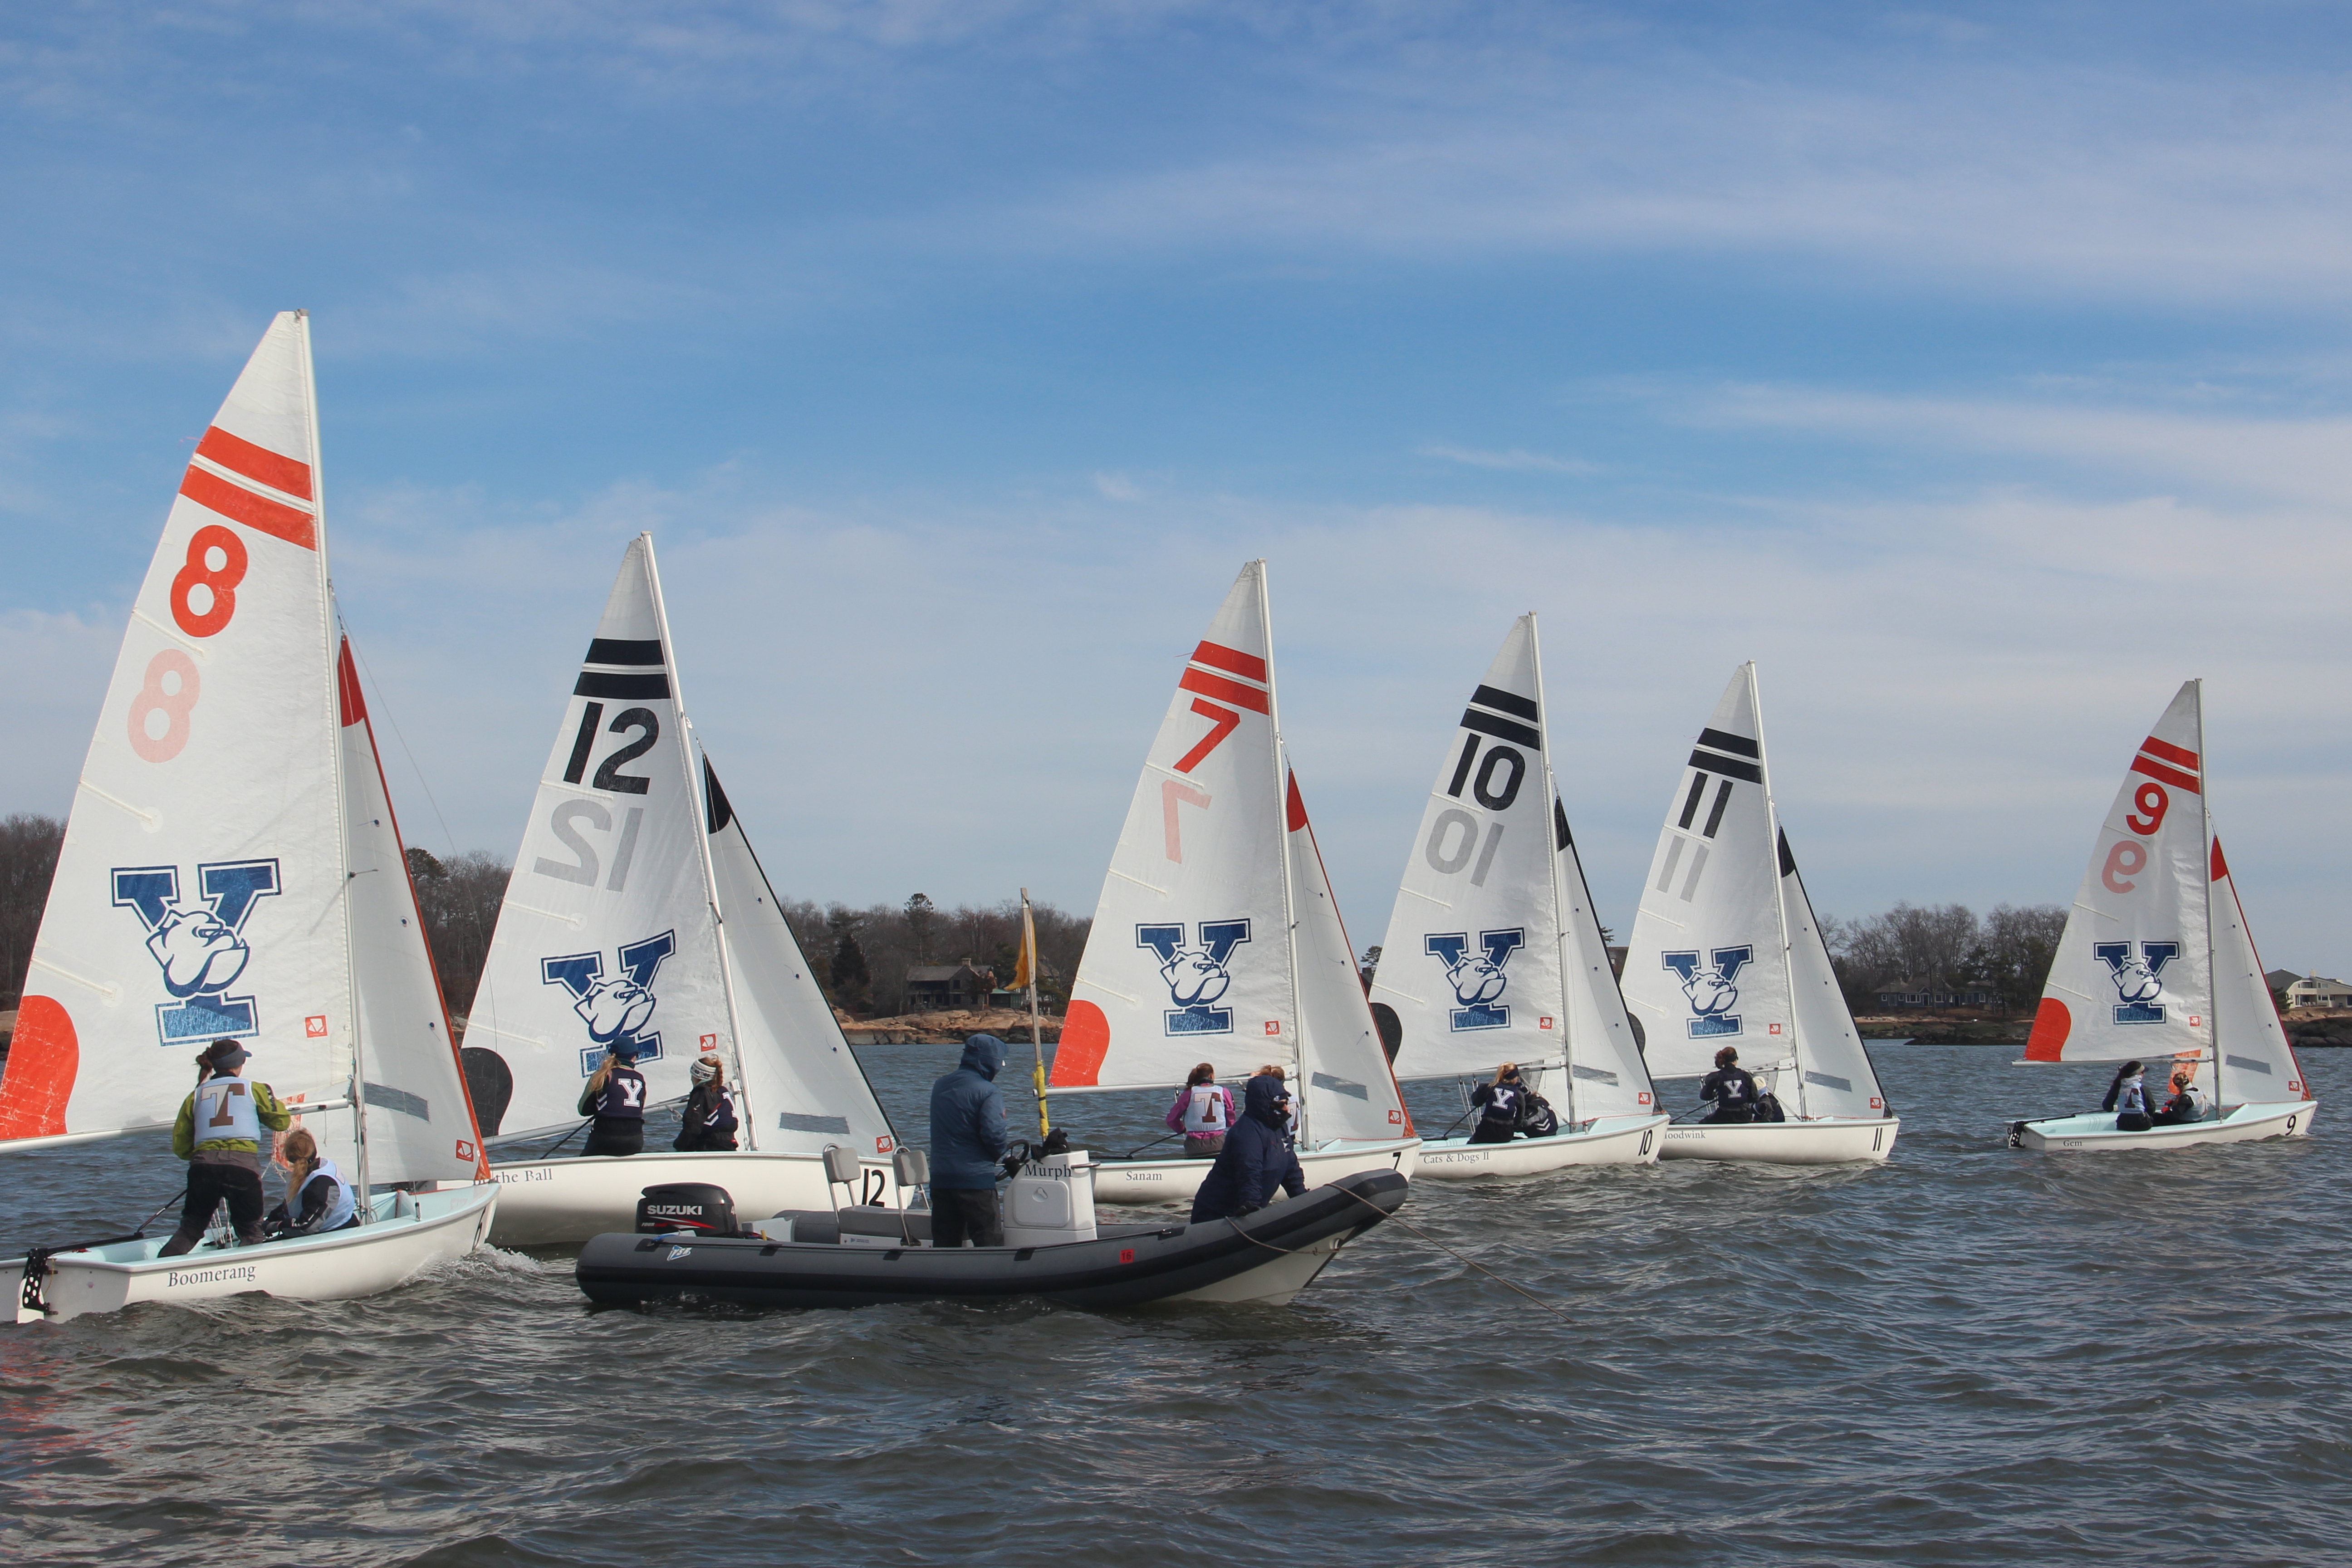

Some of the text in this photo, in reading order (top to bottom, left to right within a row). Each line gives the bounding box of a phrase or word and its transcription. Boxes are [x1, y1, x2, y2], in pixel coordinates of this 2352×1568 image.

[171, 524, 248, 637] 8
[563, 701, 660, 795] 12
[1173, 697, 1240, 774] 7
[1447, 733, 1525, 811] 10
[1678, 771, 1733, 839] 11
[2126, 782, 2169, 835] 9
[111, 858, 282, 1046] Y
[1136, 918, 1251, 1037] Y
[1424, 927, 1525, 1033] Y
[1661, 944, 1754, 1039] Y
[2093, 941, 2180, 1025] Y
[618, 1078, 643, 1107] Y
[1492, 1088, 1514, 1110] Y
[1724, 1080, 1742, 1098] Y
[2120, 1088, 2139, 1108] T
[201, 1083, 245, 1127] T
[1194, 1093, 1221, 1122] T
[1872, 1127, 1882, 1151] 11
[2285, 1115, 2296, 1136] 9
[1638, 1129, 1652, 1156] 10
[1024, 1164, 1072, 1181] Murph
[1392, 1152, 1401, 1170] 7
[1424, 1152, 1490, 1164] Cats & Dogs II
[496, 1171, 519, 1183] the
[524, 1168, 554, 1181] Ball
[862, 1168, 885, 1208] 12
[1126, 1171, 1162, 1181] Sanam
[647, 1205, 702, 1215] SUZUKI
[167, 1266, 256, 1287] Boomerang
